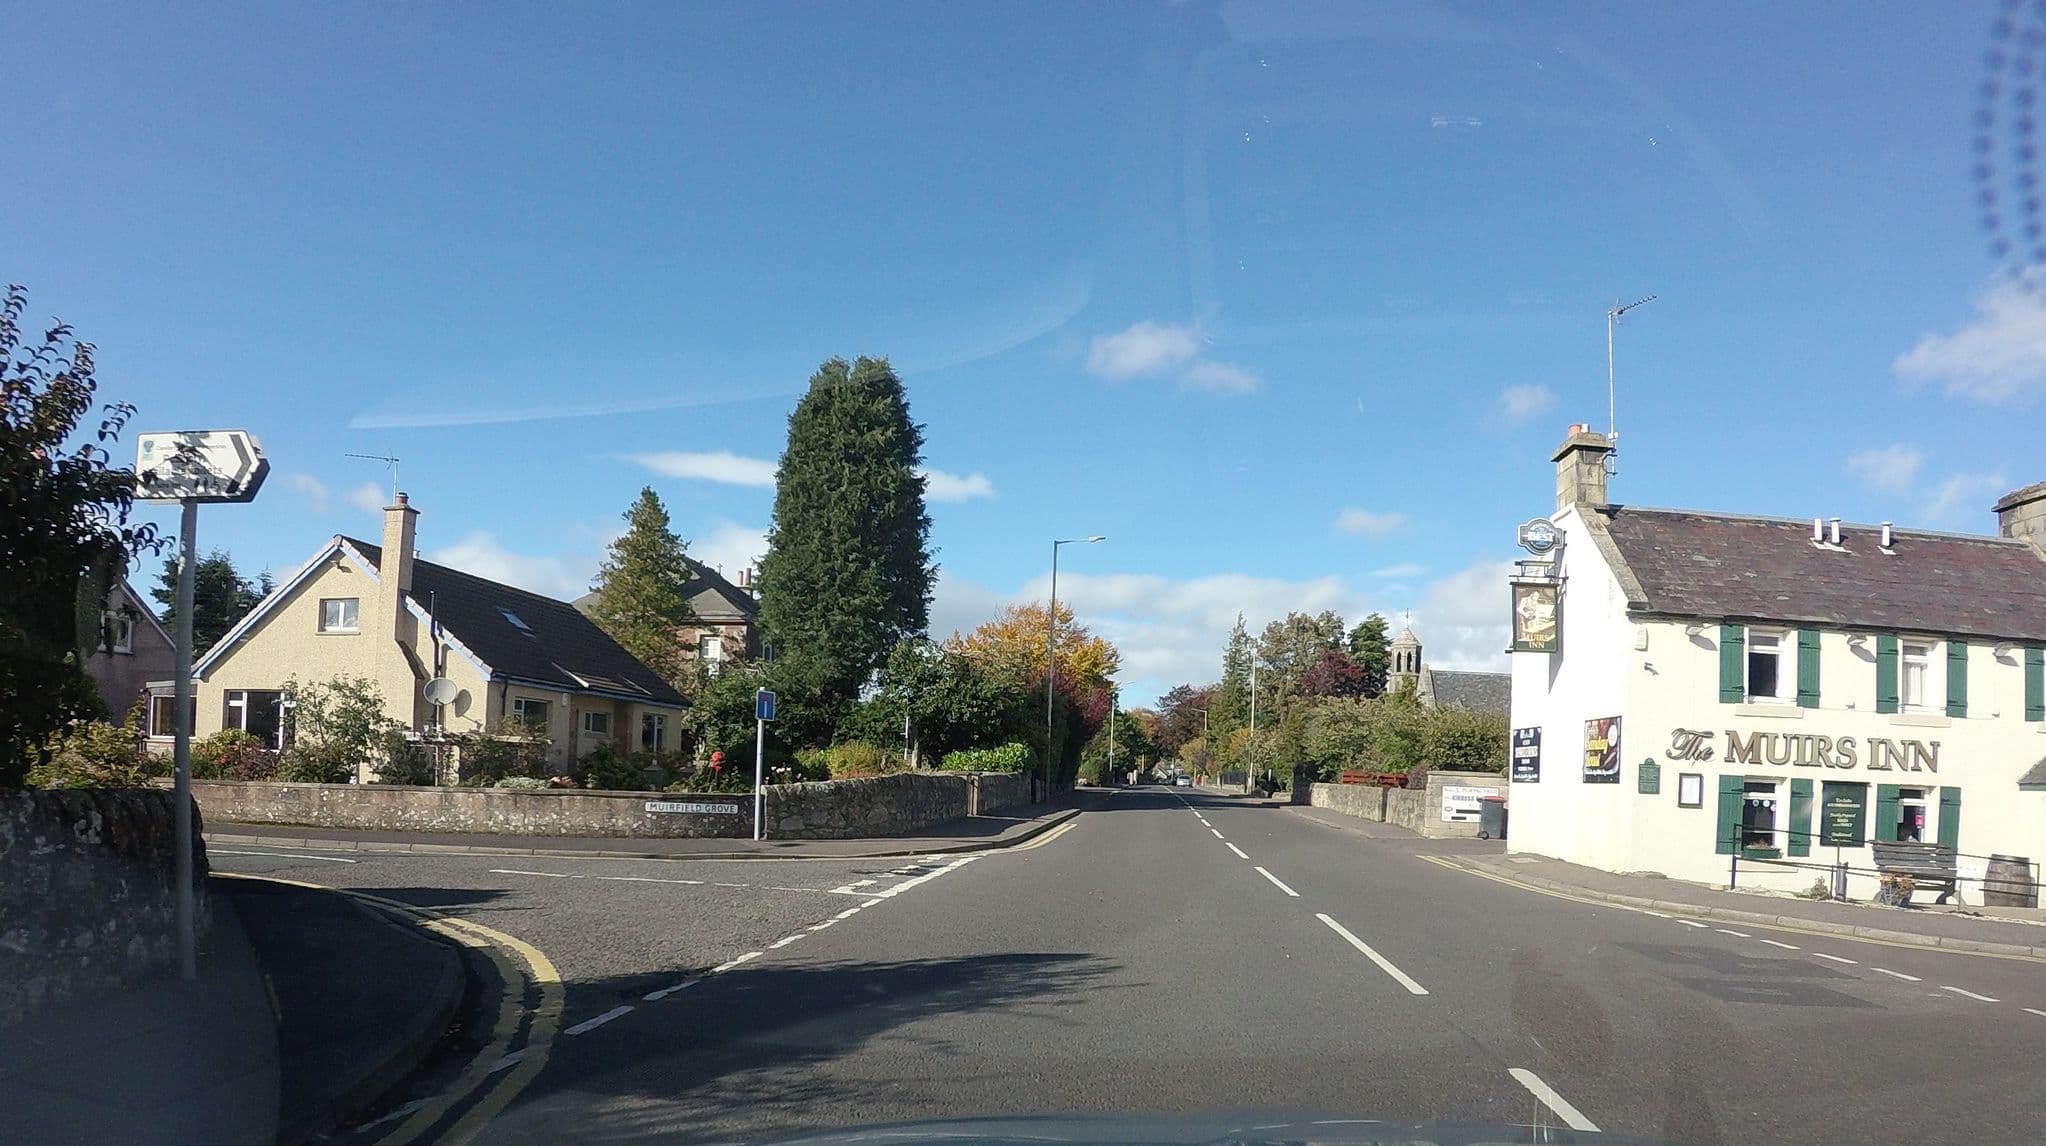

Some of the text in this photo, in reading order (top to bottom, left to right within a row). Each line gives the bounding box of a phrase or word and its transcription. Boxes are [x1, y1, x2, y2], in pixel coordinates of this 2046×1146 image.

[1529, 641, 1545, 649] INN
[1665, 727, 1941, 773] The MUIRS INN
[650, 803, 735, 813] MUIRFIELD GROVE
